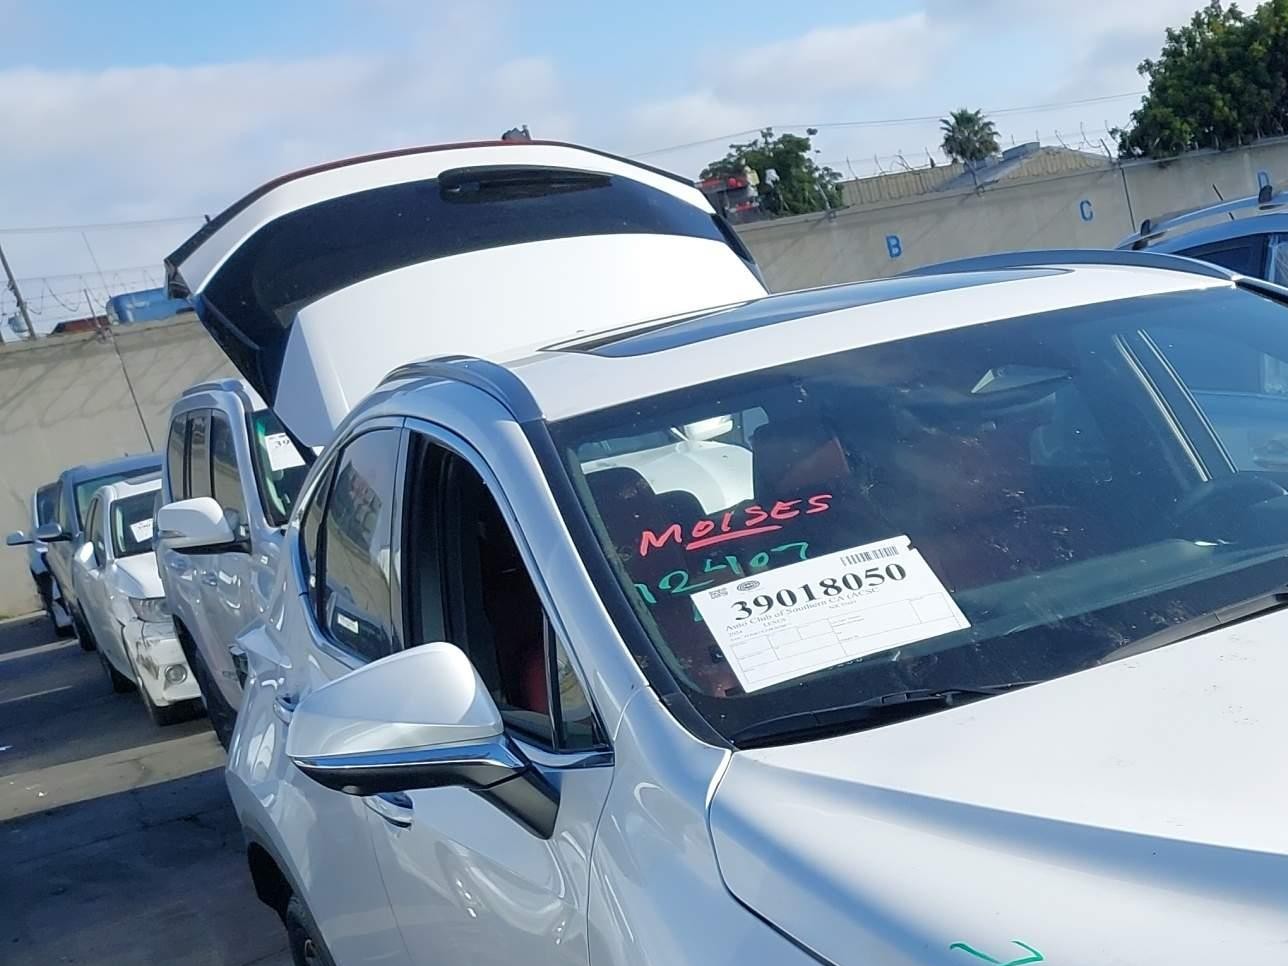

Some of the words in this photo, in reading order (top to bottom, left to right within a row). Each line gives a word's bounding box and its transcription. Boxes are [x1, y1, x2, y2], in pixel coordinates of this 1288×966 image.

[1079, 199, 1094, 222] C
[886, 235, 902, 258] B
[639, 494, 833, 557] MOISES
[731, 562, 907, 621] 39018050
[726, 619, 748, 632] Auto
[750, 613, 772, 625] Club
[774, 609, 784, 618] of
[785, 599, 828, 615] Southern
